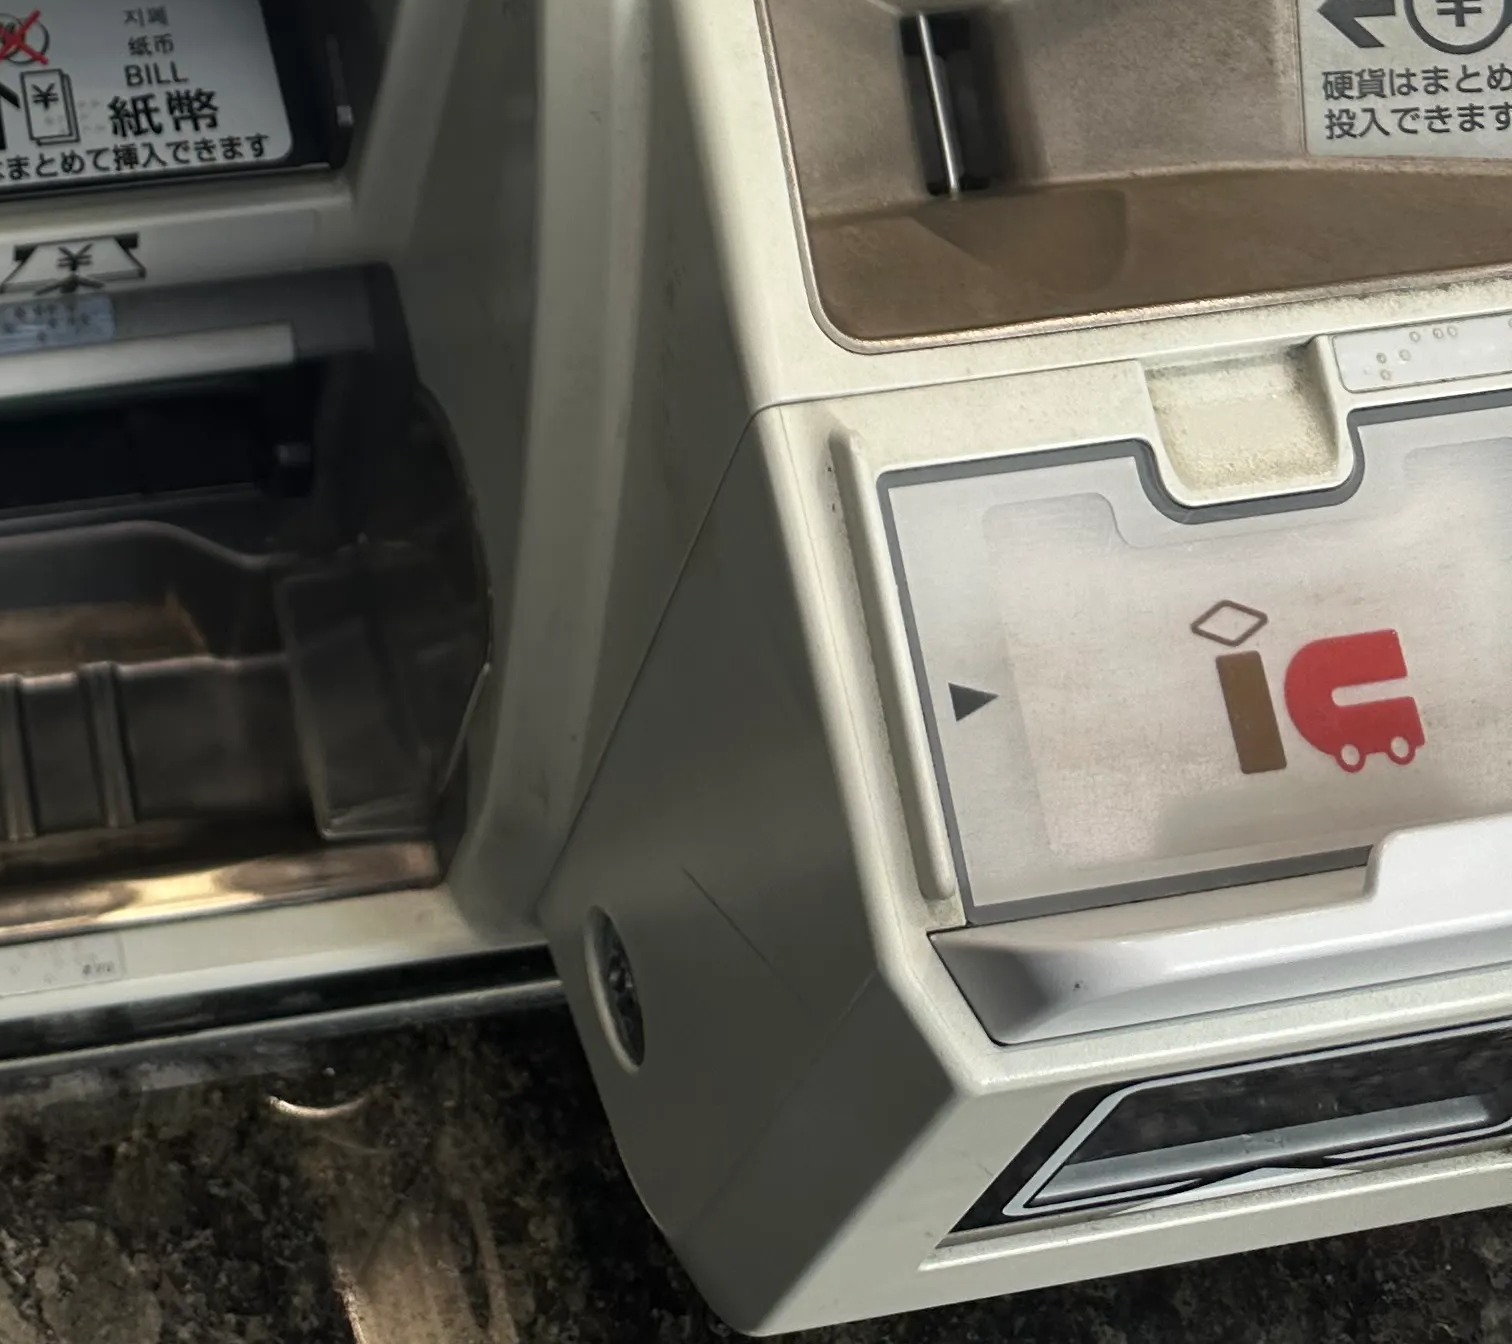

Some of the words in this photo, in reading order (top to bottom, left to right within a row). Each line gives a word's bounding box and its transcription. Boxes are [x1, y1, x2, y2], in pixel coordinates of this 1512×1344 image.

[124, 61, 189, 87] BILL
[1322, 63, 1512, 100] 硬貨はまとめ
[108, 88, 218, 137] 紙幣
[1325, 102, 1512, 139] 投入できます
